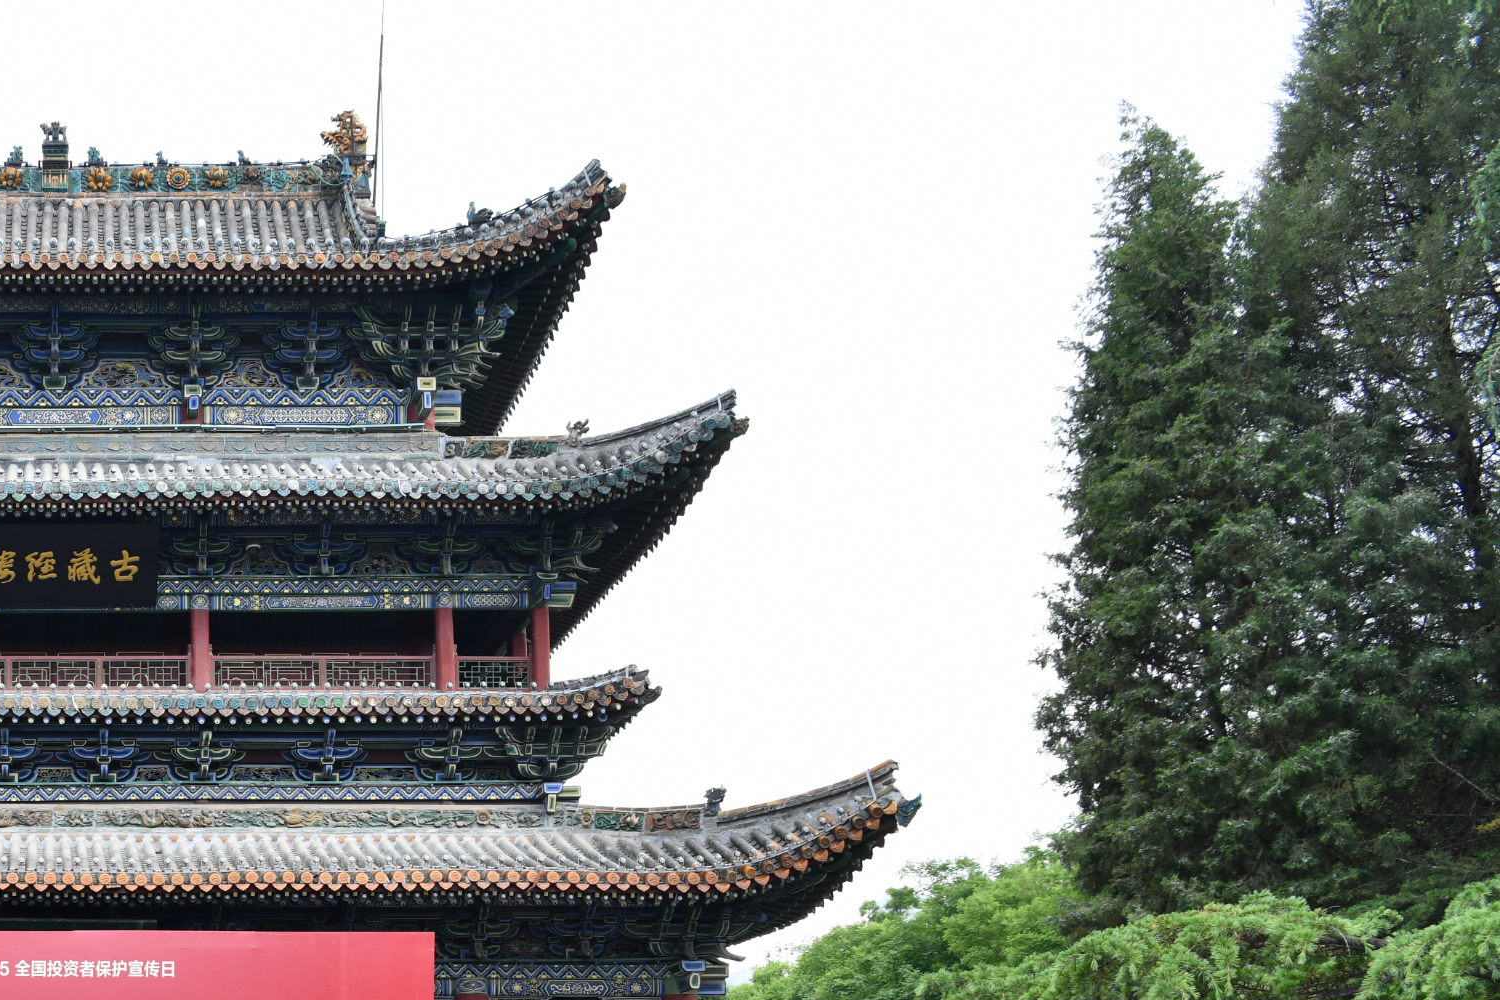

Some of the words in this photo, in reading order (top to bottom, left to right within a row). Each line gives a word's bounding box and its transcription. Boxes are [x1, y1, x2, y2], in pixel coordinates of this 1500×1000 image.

[14, 959, 176, 978] 全国投资者保护宣传日
